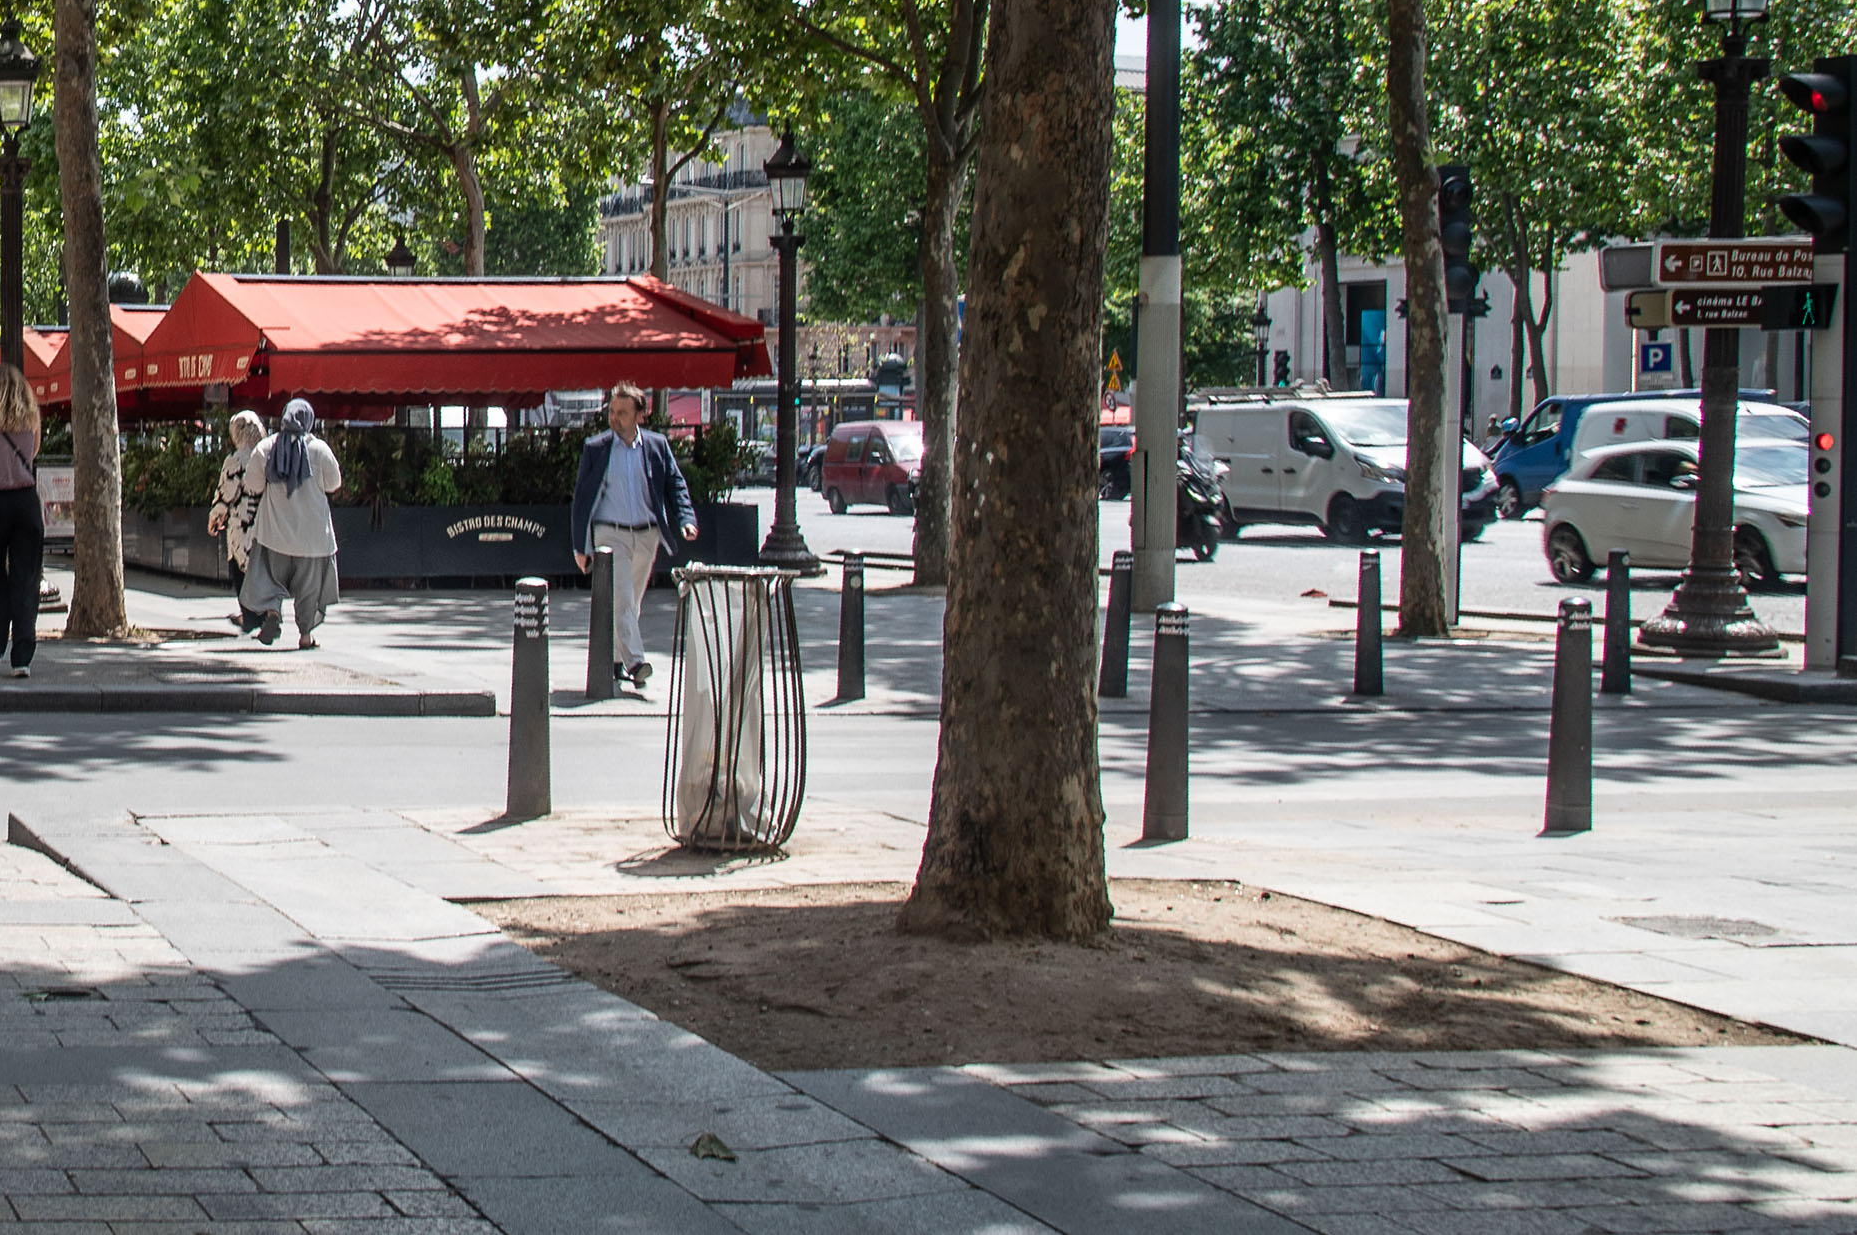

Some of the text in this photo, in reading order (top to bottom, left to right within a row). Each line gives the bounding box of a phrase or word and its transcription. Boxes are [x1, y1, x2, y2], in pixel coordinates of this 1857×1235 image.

[1731, 249, 1813, 262] Bureau de Pos
[1732, 265, 1747, 278] 10,
[1752, 265, 1774, 278] Rue
[1736, 295, 1749, 307] LE
[1649, 348, 1663, 369] P
[446, 515, 546, 539] BISTRO DES CHAMPS
